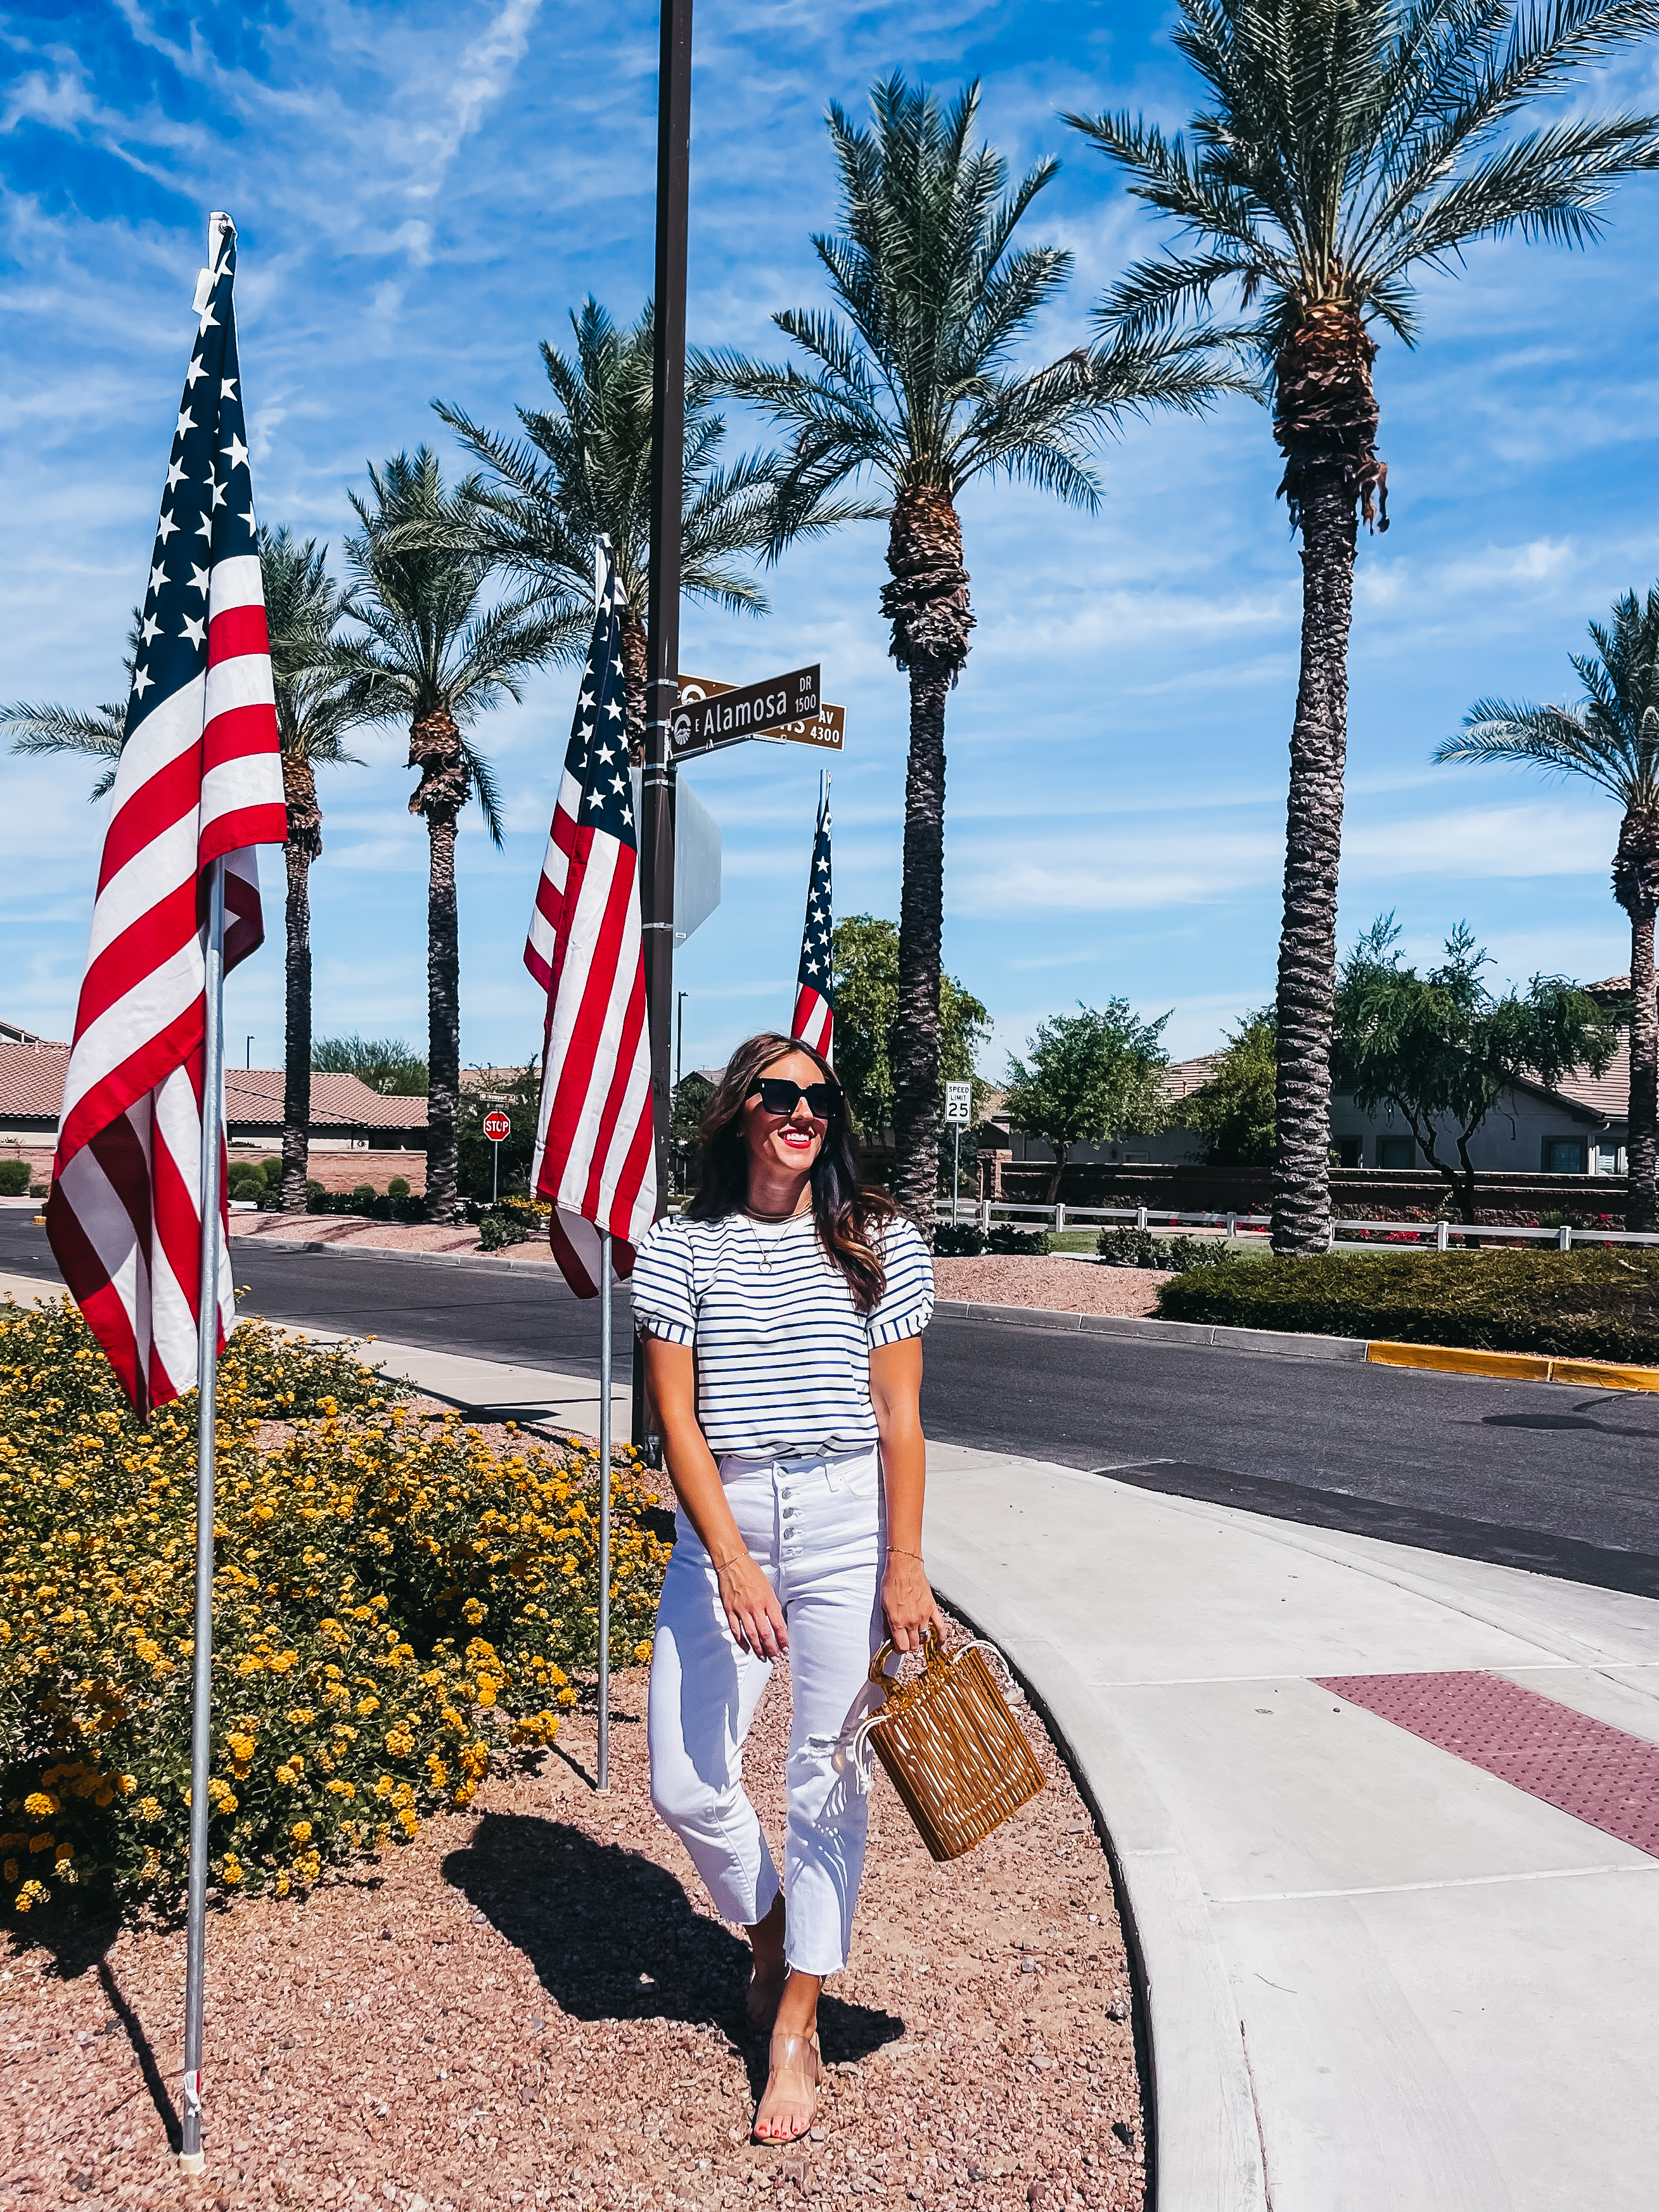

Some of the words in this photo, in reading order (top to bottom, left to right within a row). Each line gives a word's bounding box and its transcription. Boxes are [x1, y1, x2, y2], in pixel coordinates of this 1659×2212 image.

[800, 675, 811, 692] DR
[795, 694, 816, 713] 1500
[695, 719, 700, 732] E
[703, 691, 786, 736] Alamosa
[818, 710, 834, 725] AV
[810, 726, 840, 743] 4300
[948, 1103, 968, 1117] 25
[485, 1120, 509, 1132] STOP
